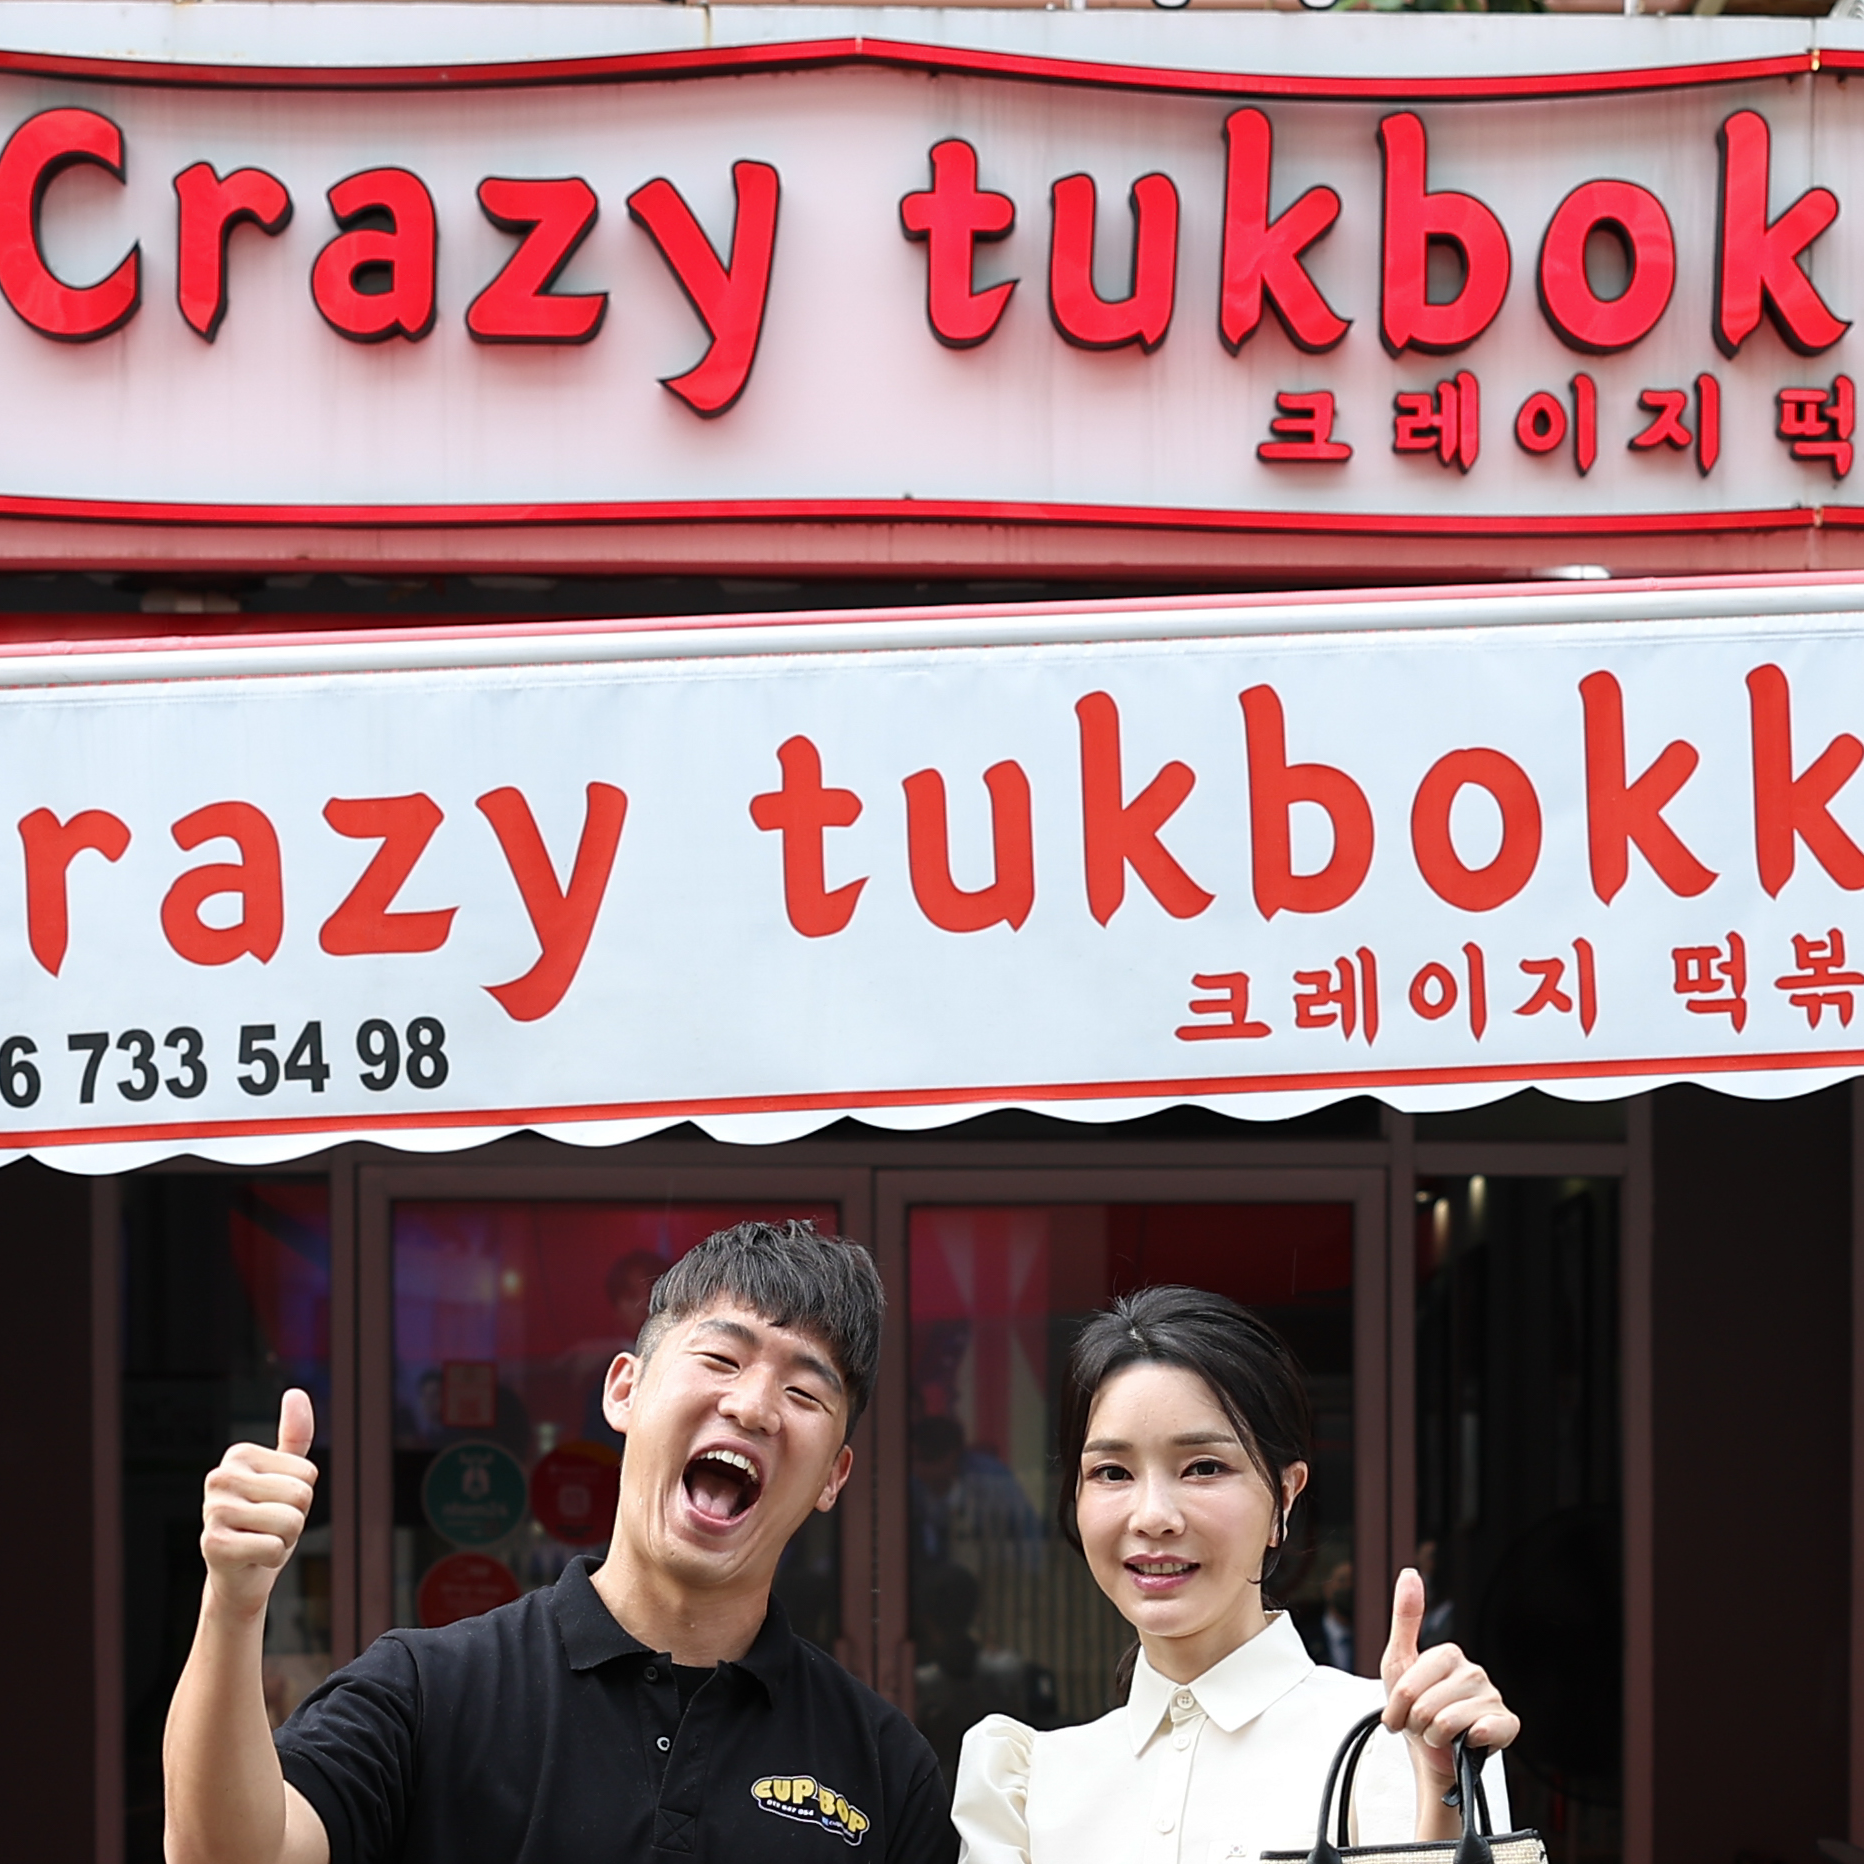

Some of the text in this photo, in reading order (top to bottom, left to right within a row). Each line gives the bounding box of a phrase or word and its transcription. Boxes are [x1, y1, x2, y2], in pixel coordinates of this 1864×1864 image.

[1174, 936, 1598, 1047] 크레이지
[66, 1026, 208, 1104] 733
[237, 1020, 330, 1096] 54
[356, 1015, 449, 1091] 98
[752, 1778, 816, 1805] CUP
[818, 1788, 868, 1833] BOP
